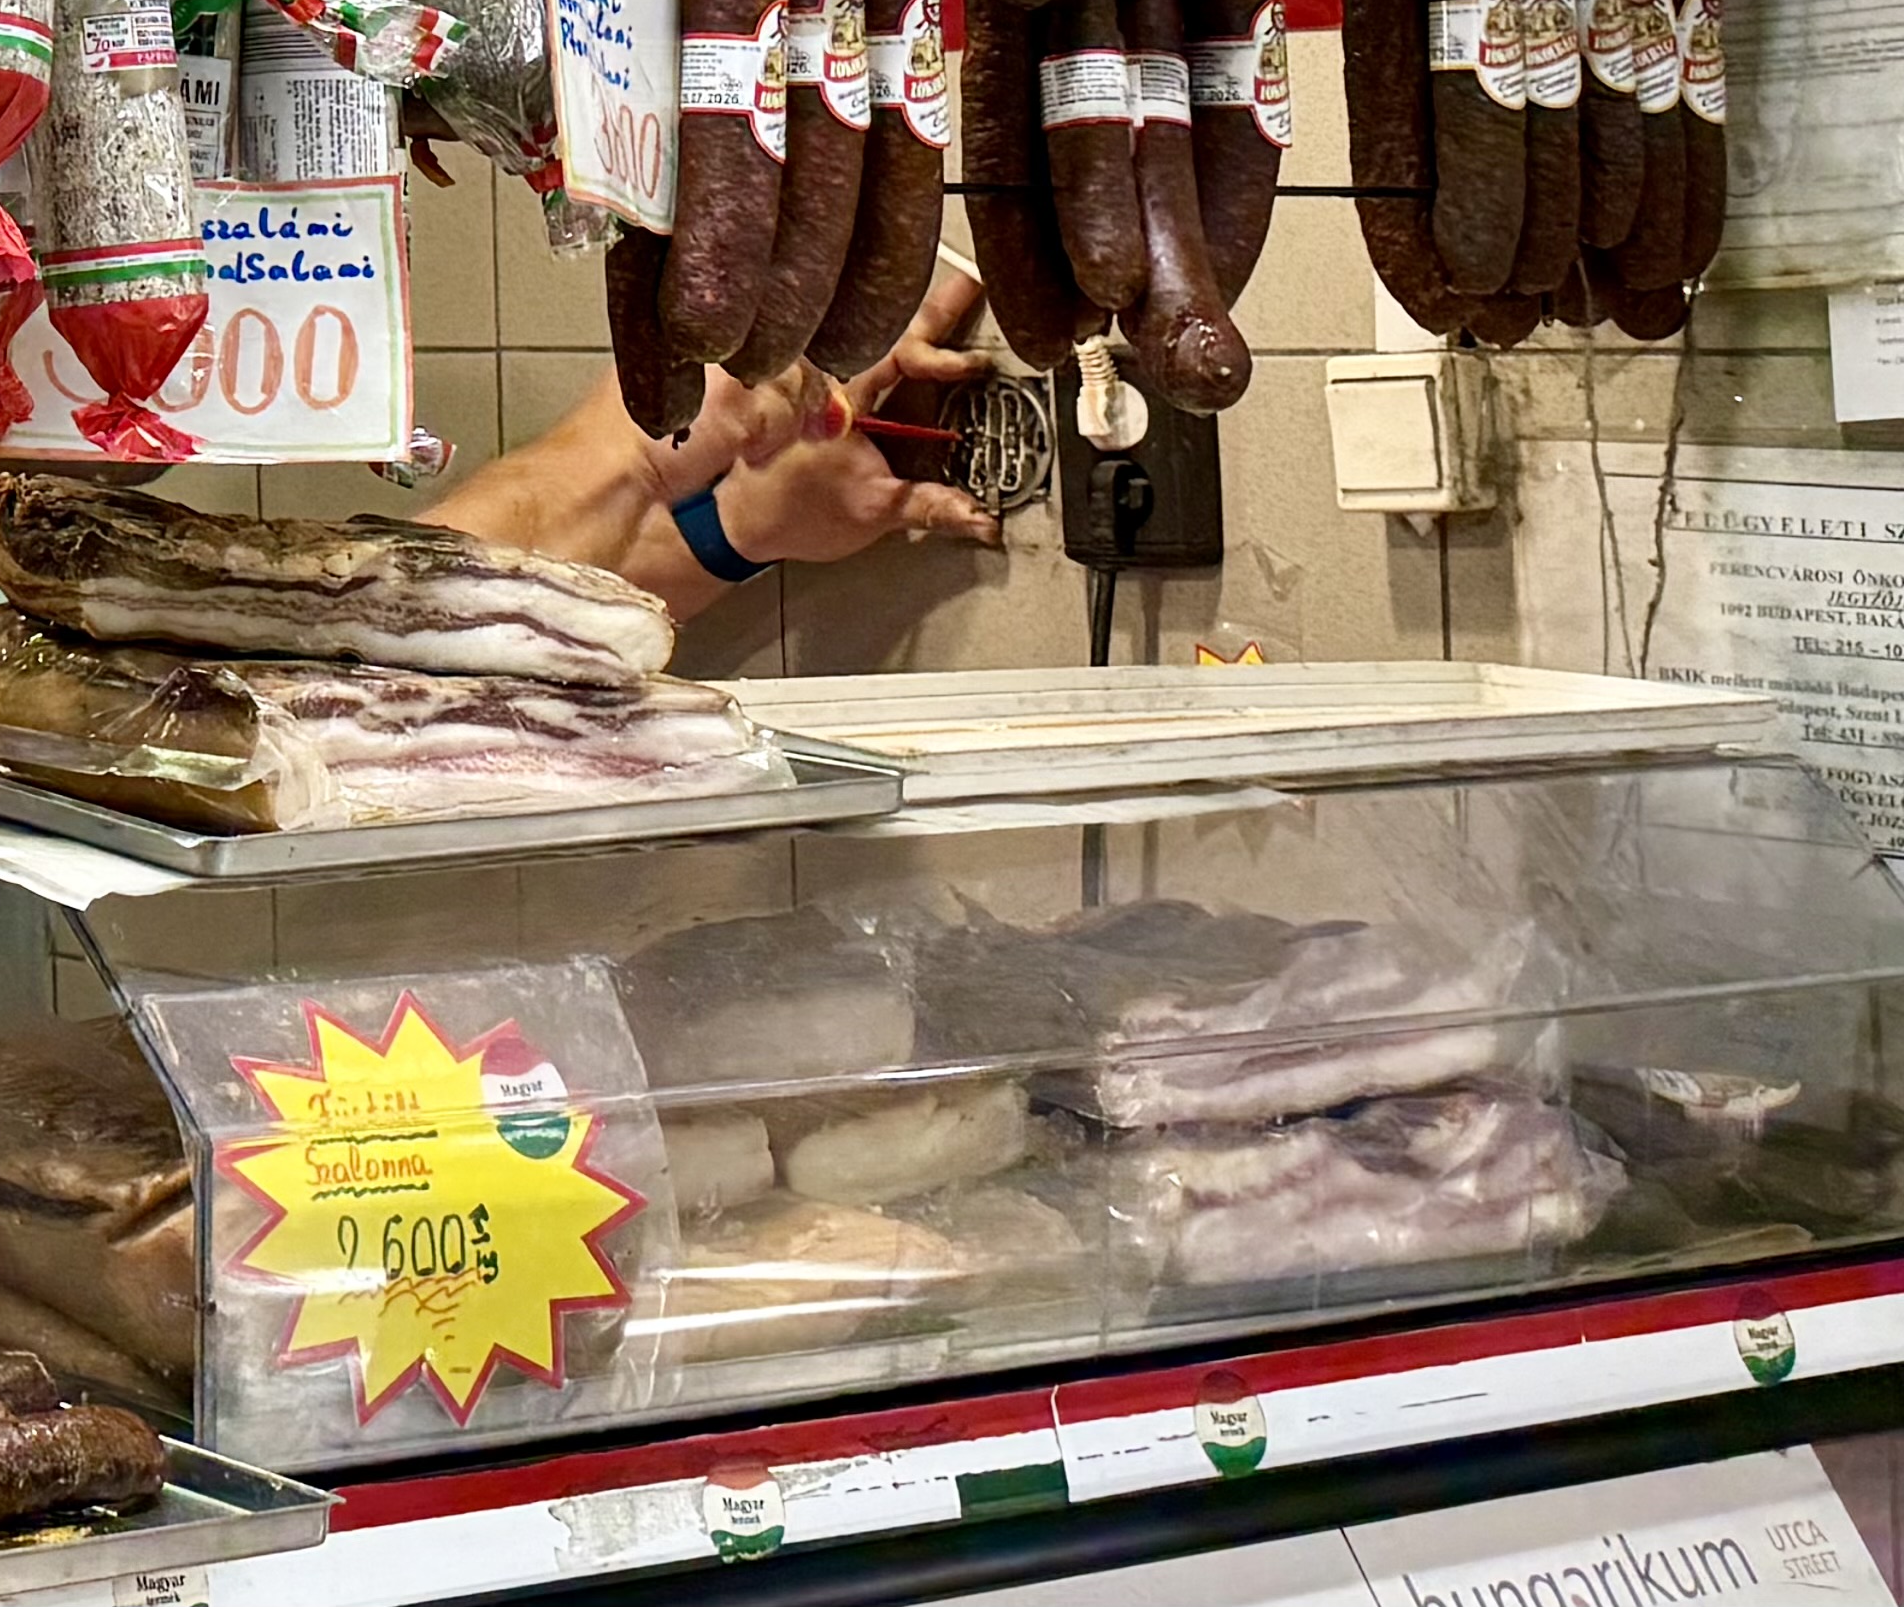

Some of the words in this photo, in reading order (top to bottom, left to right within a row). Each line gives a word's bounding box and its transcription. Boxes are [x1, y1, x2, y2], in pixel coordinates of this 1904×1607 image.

[1709, 561, 1845, 586] FERENCVÁROSI
[1835, 637, 1864, 656] 215
[1658, 665, 1706, 685] BKIK
[304, 1144, 433, 1187] Szalonna
[1765, 1517, 1830, 1553] UTCA
[1782, 1551, 1843, 1580] STREET
[136, 1574, 187, 1594] Magyar
